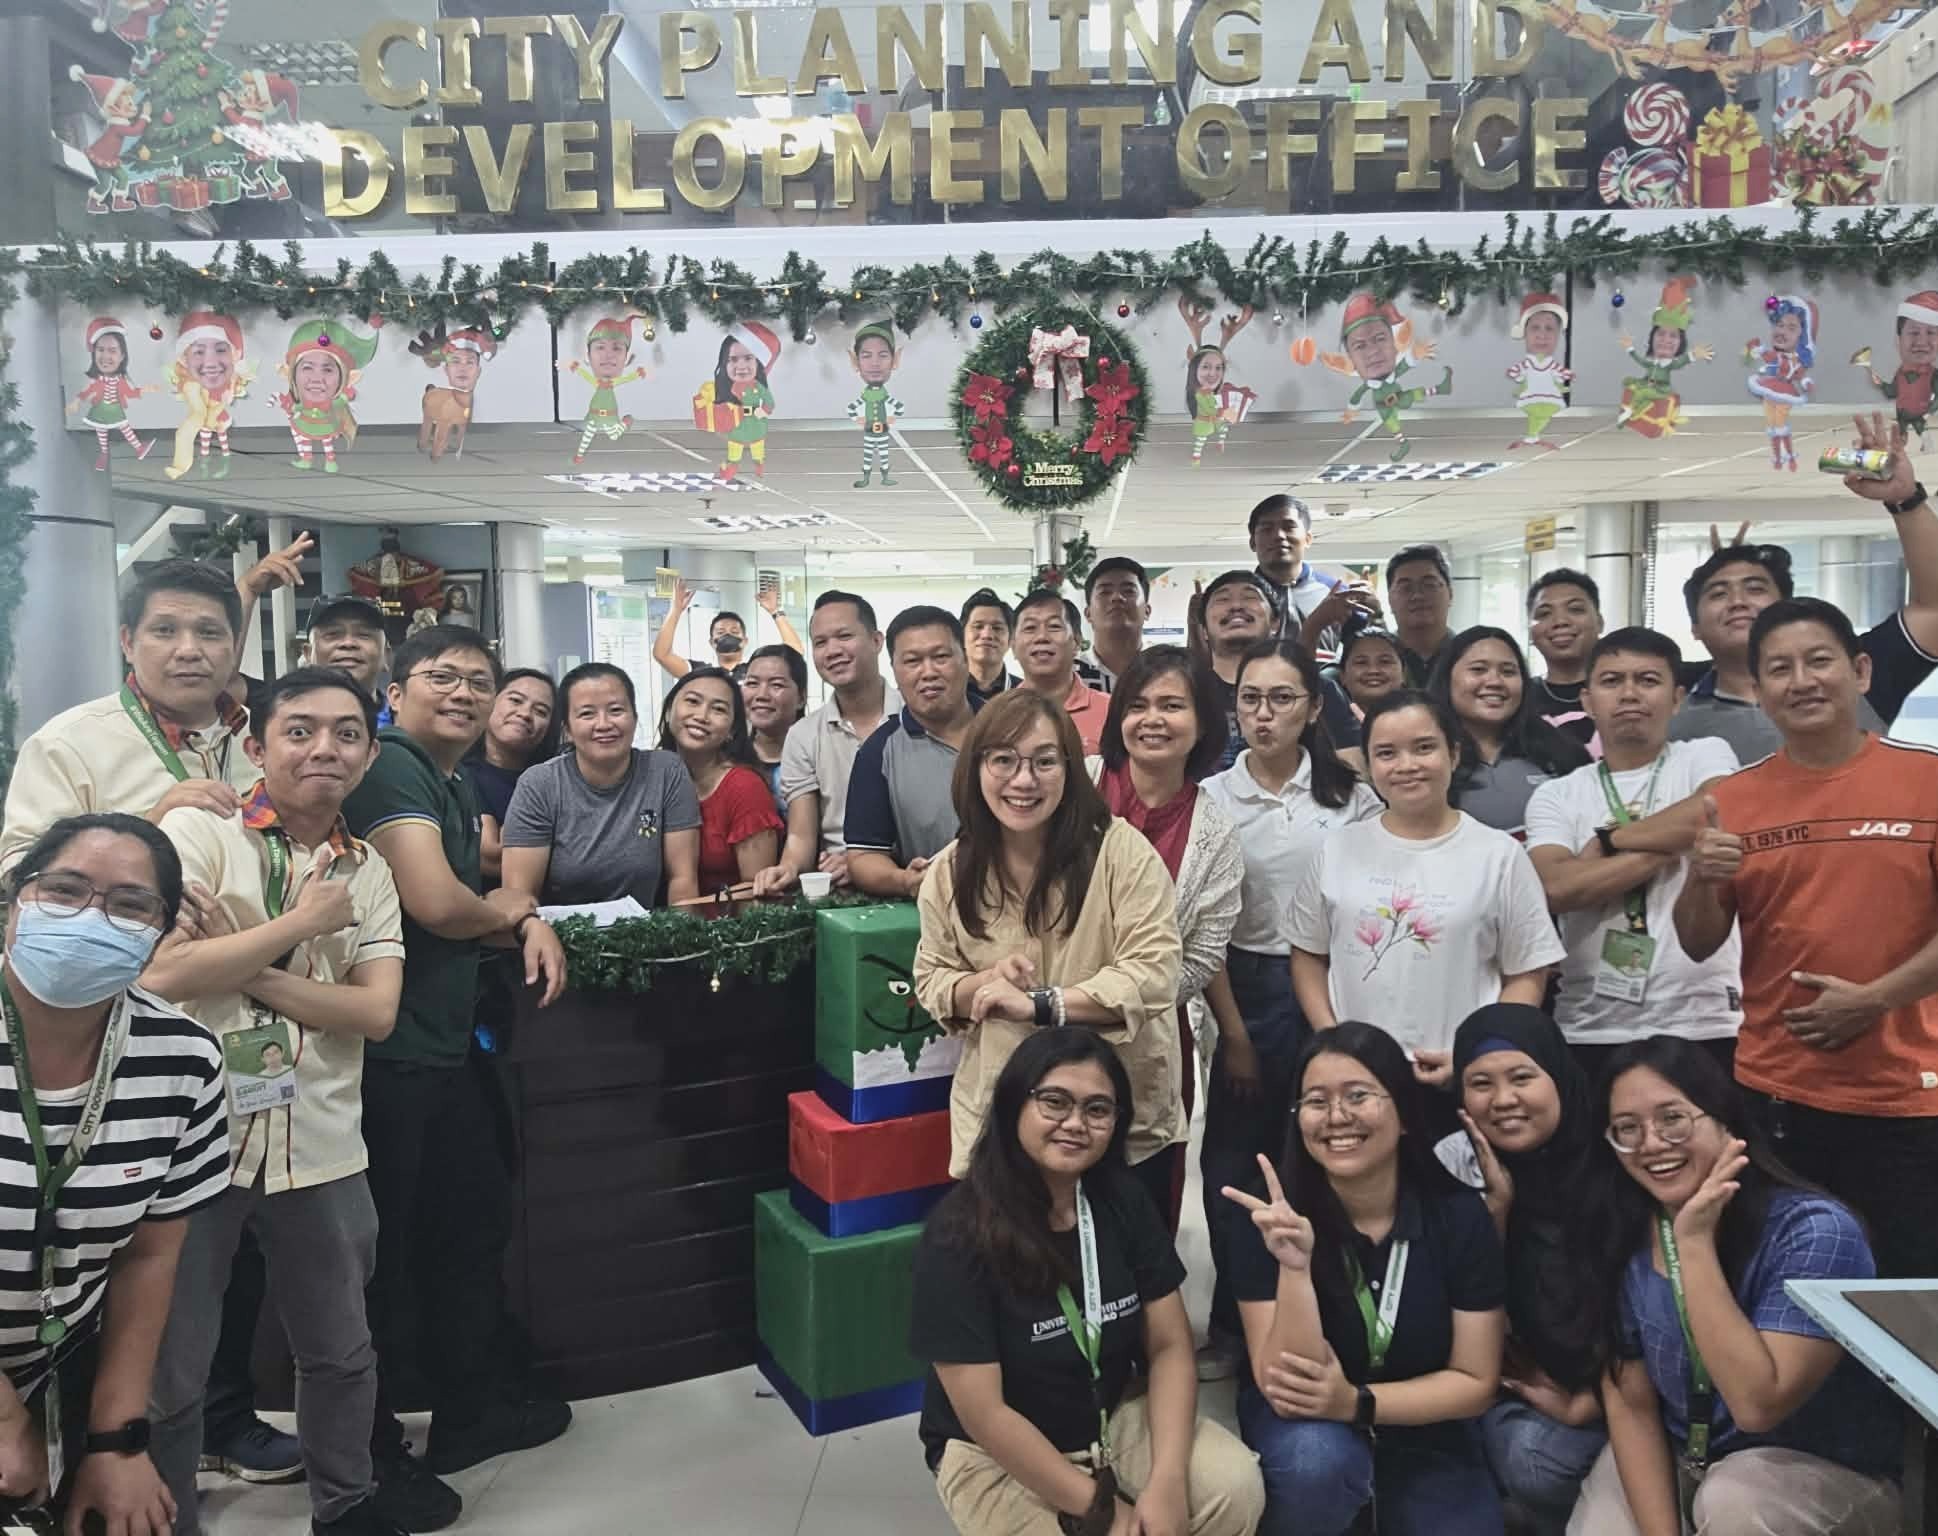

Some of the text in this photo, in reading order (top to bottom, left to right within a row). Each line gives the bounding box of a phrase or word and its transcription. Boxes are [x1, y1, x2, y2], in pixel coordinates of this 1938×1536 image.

[358, 0, 1540, 109] CITY PLANNING AND
[322, 97, 1590, 217] DEVELOPMENT OFFICE
[1033, 462, 1074, 475] Merry
[1023, 475, 1084, 487] Christmas
[1849, 822, 1913, 837] JAG
[81, 1111, 97, 1135] CITY
[1088, 1291, 1097, 1312] CITY
